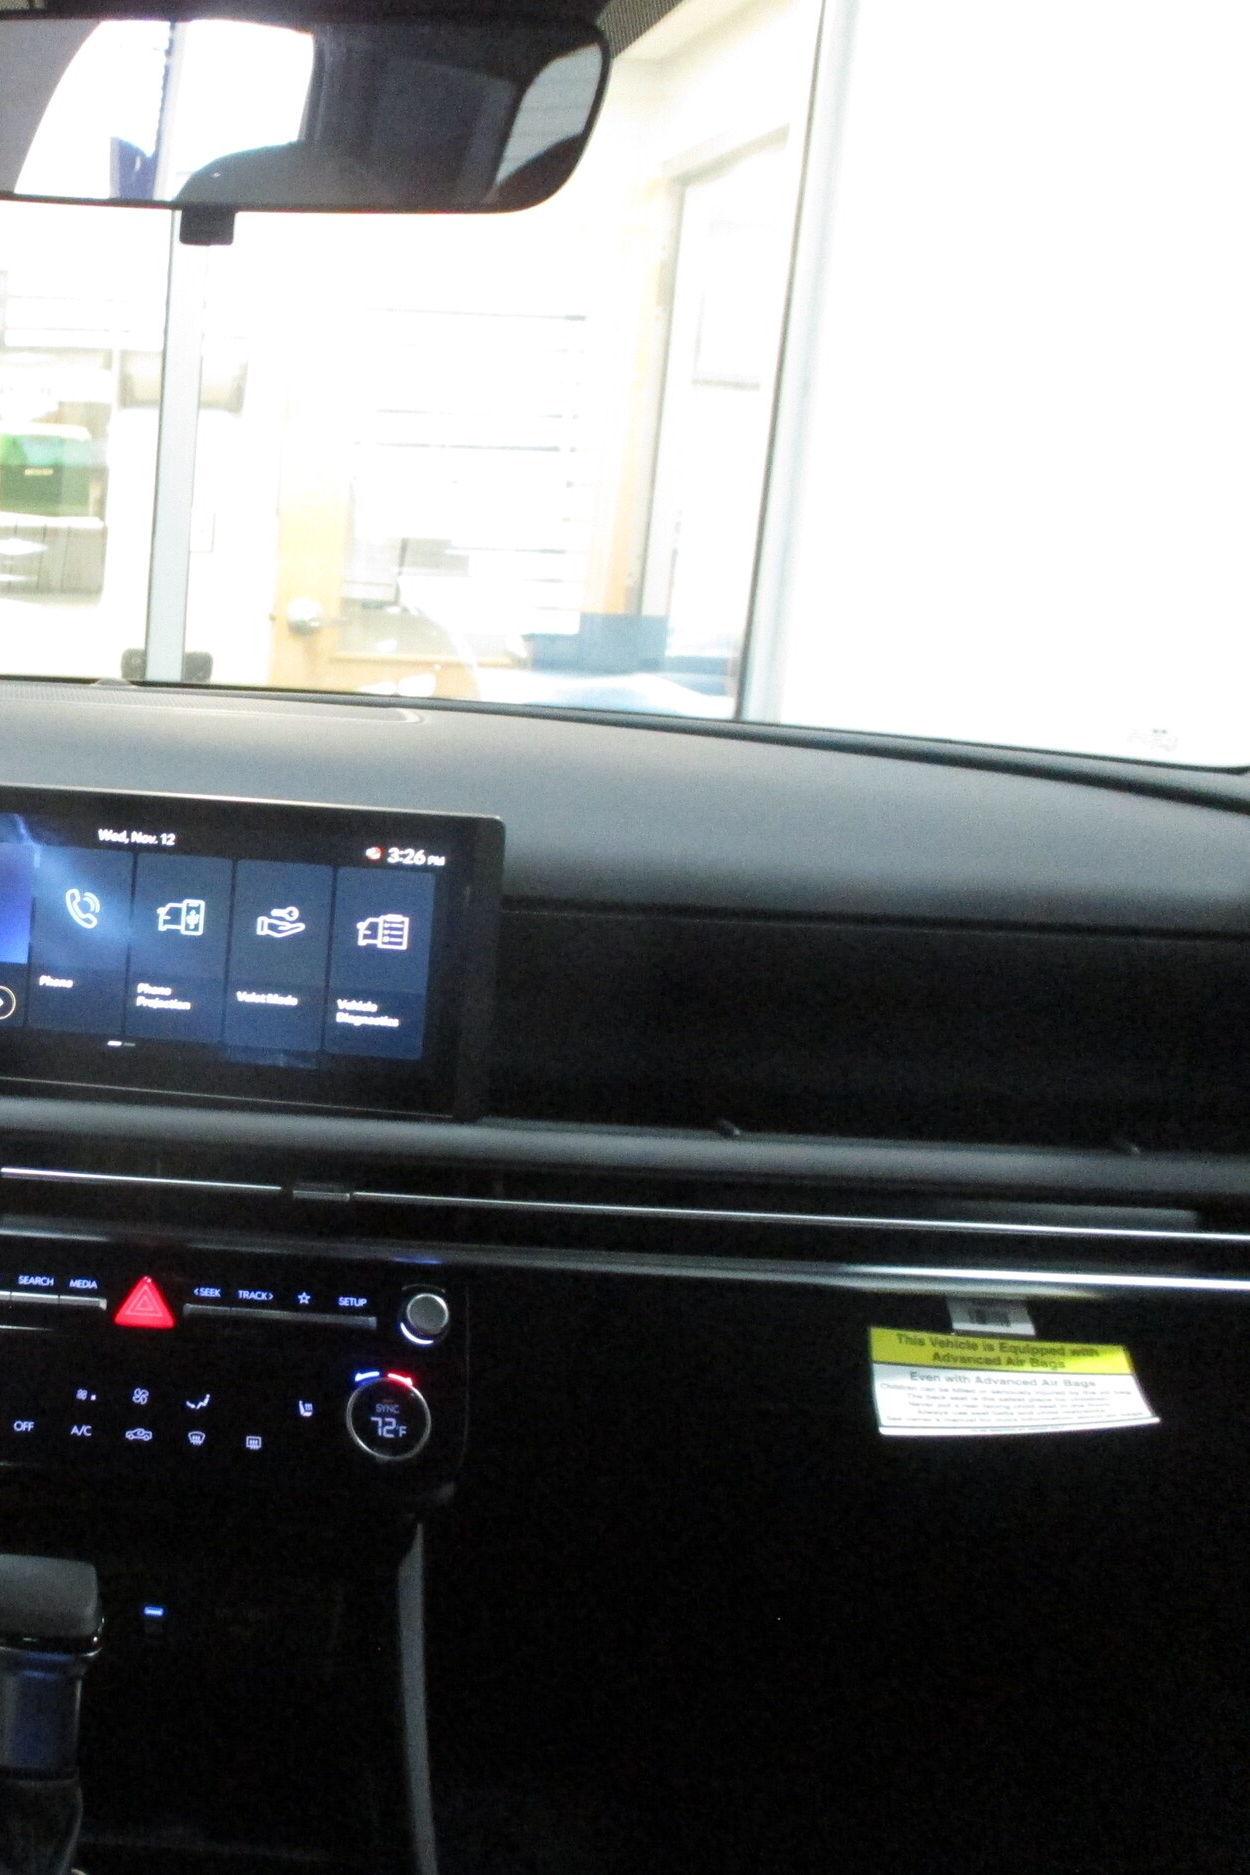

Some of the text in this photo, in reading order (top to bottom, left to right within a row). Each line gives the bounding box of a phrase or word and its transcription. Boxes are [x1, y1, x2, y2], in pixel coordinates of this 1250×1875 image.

[98, 828, 176, 846] Wed, Nov. 12
[387, 847, 446, 866] 3:26 PM
[38, 974, 74, 988] Phone
[136, 982, 172, 996] Phone
[136, 996, 191, 1010] Projection
[236, 990, 266, 1004] Valet
[337, 998, 378, 1012] Vehicle
[336, 1012, 399, 1028] Diagnostics
[18, 1275, 54, 1286] SEARCH
[69, 1278, 98, 1289] MEDIA
[338, 1296, 368, 1307] SETUP
[896, 1333, 926, 1346] This
[929, 1338, 979, 1351] Vehicle
[982, 1341, 995, 1352] is
[998, 1341, 1066, 1357] Equipped
[932, 1352, 1066, 1370] Advanced Air Bags
[910, 1371, 1096, 1388] Even with Advanced Air Bags
[376, 1404, 400, 1414] SYNC
[14, 1420, 35, 1432] OFF
[70, 1425, 92, 1436] A/C
